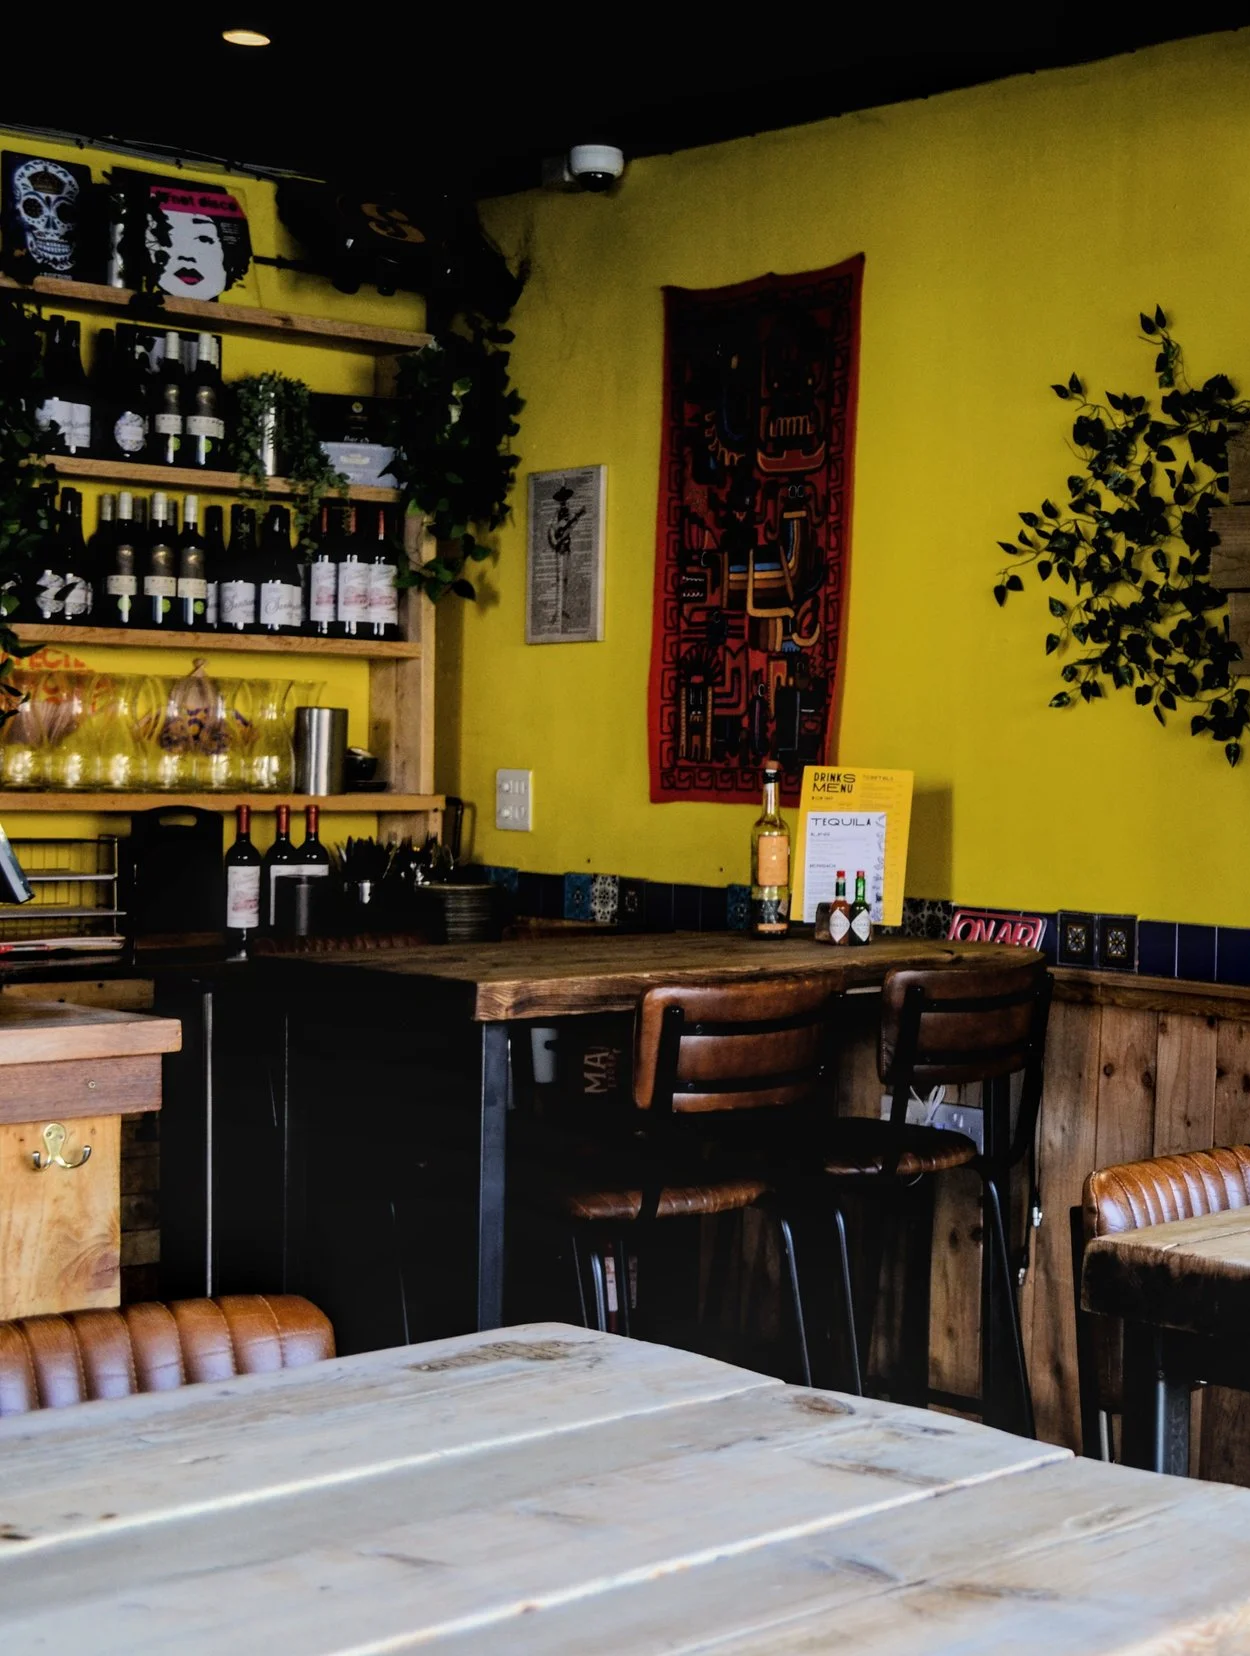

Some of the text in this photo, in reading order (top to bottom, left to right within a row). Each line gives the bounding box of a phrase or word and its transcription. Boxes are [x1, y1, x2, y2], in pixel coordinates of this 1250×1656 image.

[813, 771, 856, 784] DRINKS
[812, 782, 854, 793] MENU
[810, 817, 871, 827] TEQUILA
[955, 917, 996, 942] ON
